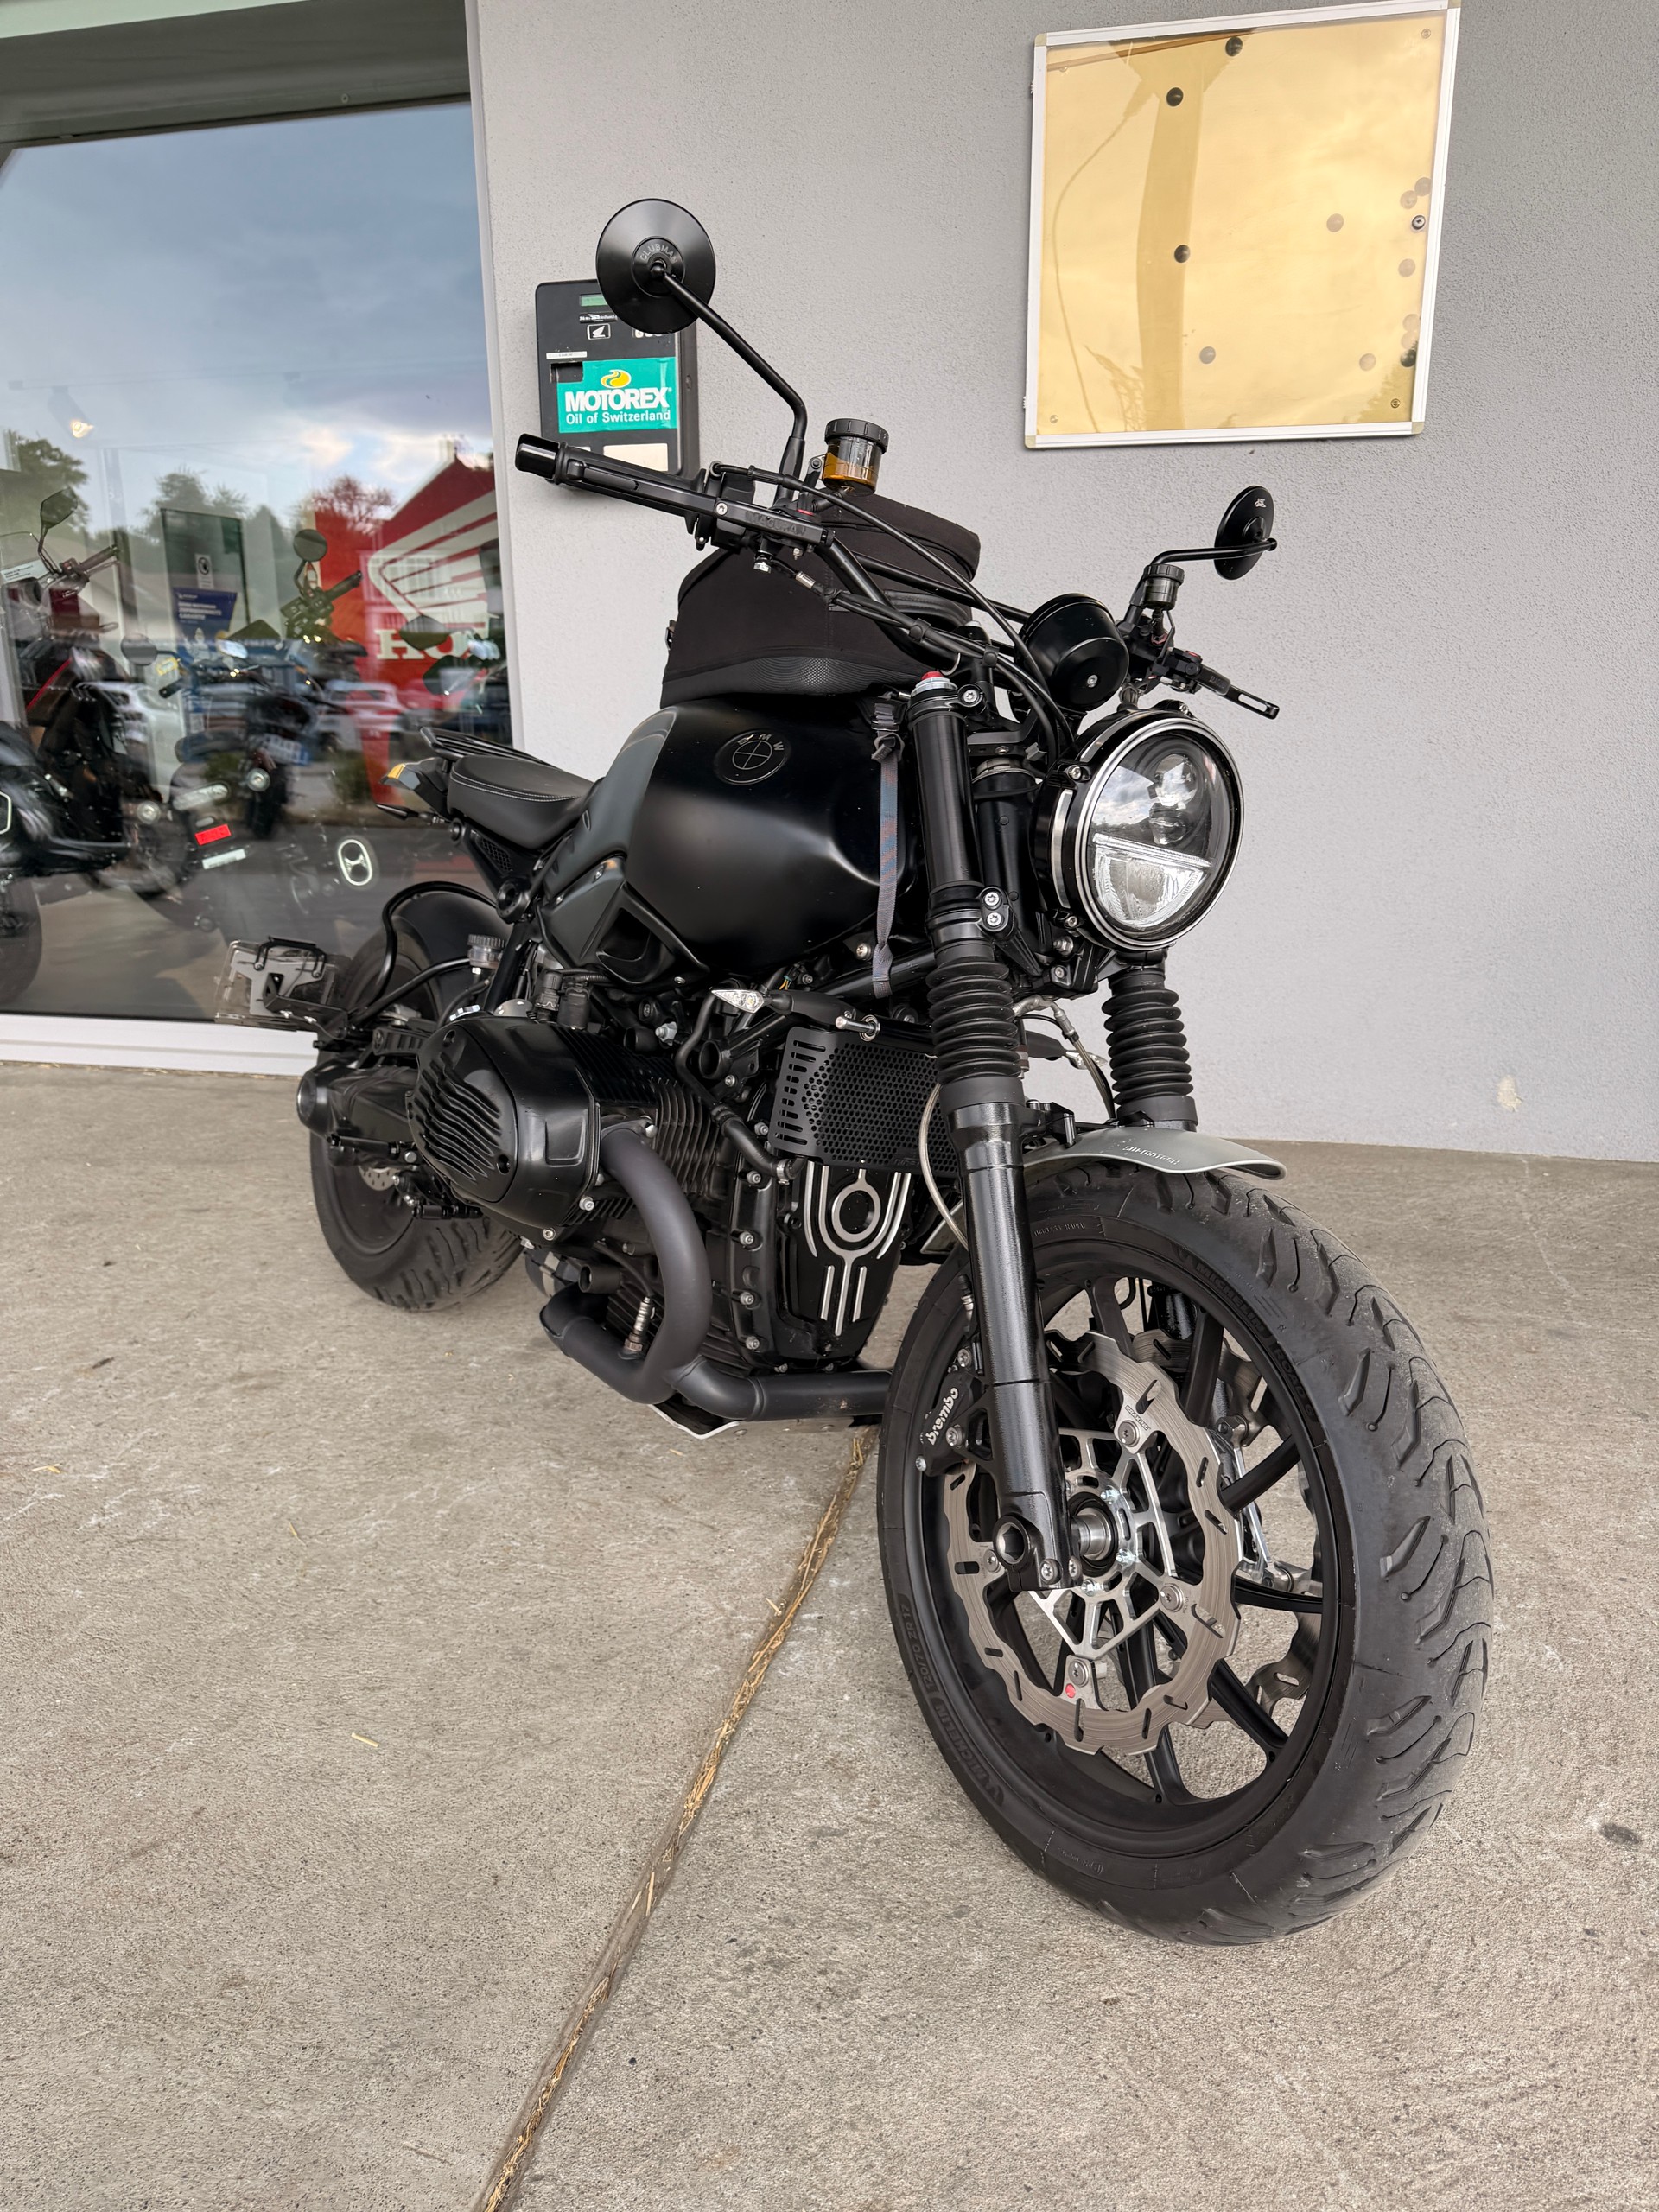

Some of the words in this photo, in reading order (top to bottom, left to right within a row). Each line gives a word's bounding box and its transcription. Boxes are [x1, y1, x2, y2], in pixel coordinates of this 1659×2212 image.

[639, 243, 678, 264] CLUBMAN
[564, 386, 671, 412] MOTOREX
[566, 413, 582, 424] Oil
[587, 412, 598, 423] of
[602, 410, 671, 423] Switzerland
[1194, 1262, 1265, 1332] MICHELIN
[925, 1387, 959, 1446] brembo
[902, 1605, 911, 1618] 17
[906, 1622, 917, 1638] ZR
[912, 1644, 934, 1688] 120/70
